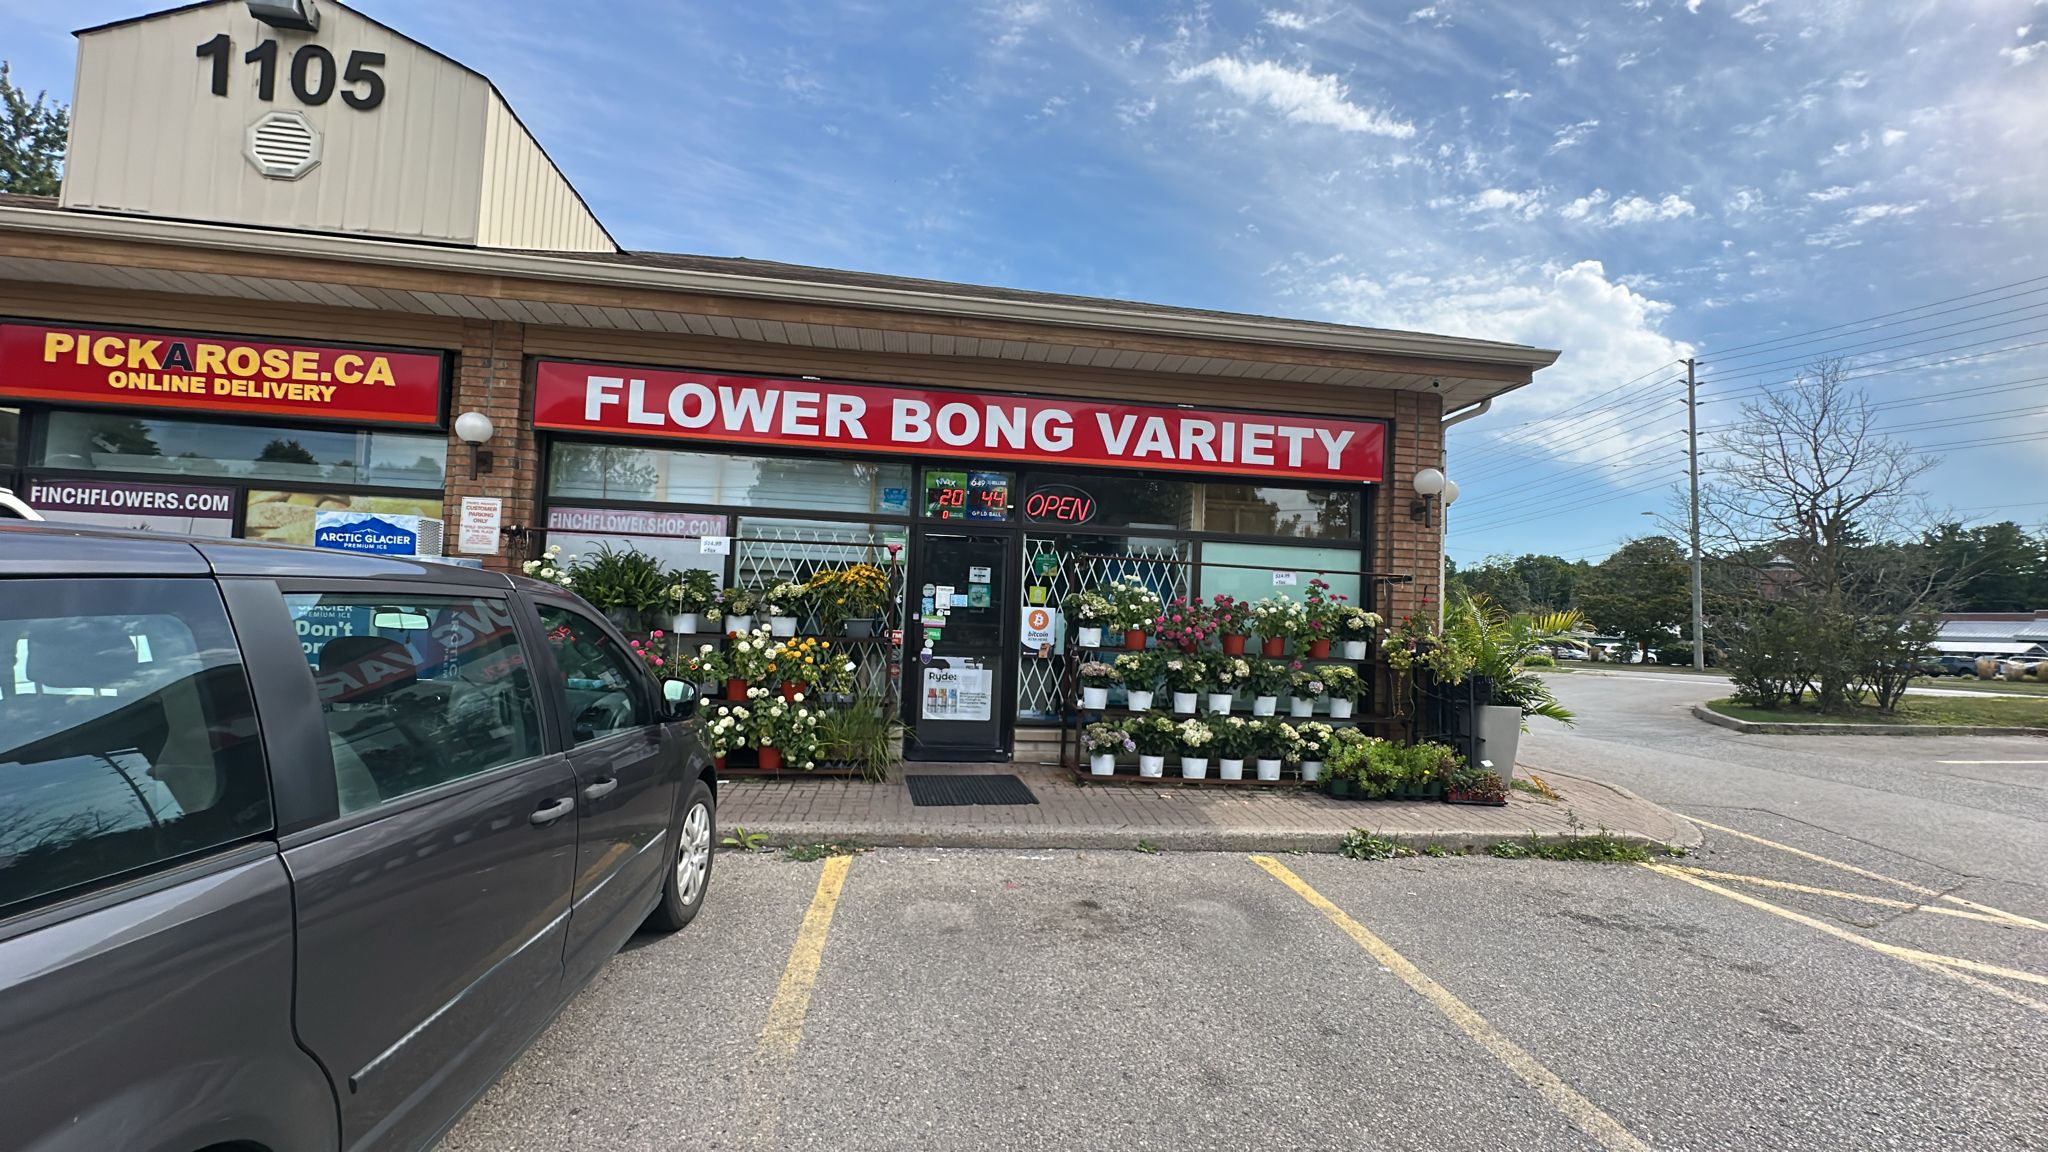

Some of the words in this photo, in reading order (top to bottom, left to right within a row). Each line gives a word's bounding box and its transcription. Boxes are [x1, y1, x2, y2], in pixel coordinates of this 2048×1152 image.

[196, 33, 386, 110] 1105
[43, 332, 396, 386] PICKAROSE.CA
[108, 370, 206, 395] ONLINE
[214, 378, 337, 403] DELIVERY
[585, 376, 868, 439] FLOWER
[891, 398, 1074, 451] BONG
[1096, 412, 1355, 470] VARIETY
[30, 485, 229, 512] FINCHFLOWERS.COM
[940, 488, 964, 506] 20
[982, 490, 1006, 508] 44
[1026, 494, 1091, 521] OPEN
[550, 512, 721, 536] FINCHFLOWERSHOP.COM
[320, 532, 362, 544] ARCTIC
[364, 535, 410, 545] GLACIER
[295, 620, 353, 637] Don't
[928, 672, 957, 682] Ryde:
